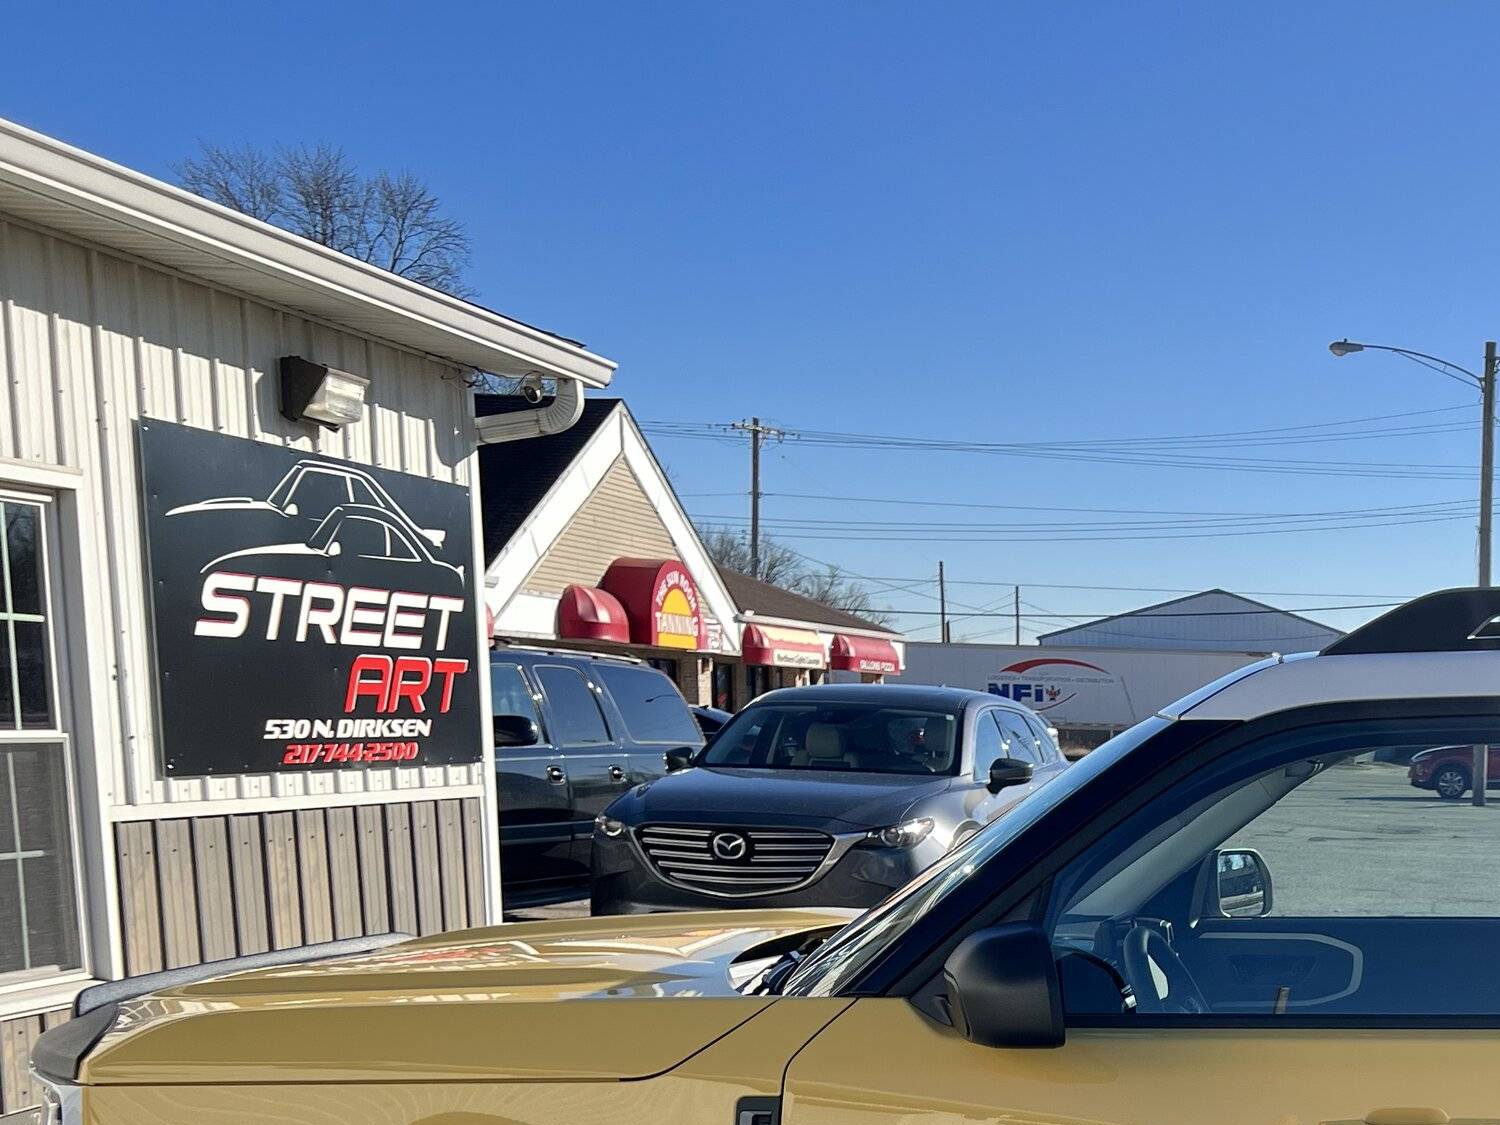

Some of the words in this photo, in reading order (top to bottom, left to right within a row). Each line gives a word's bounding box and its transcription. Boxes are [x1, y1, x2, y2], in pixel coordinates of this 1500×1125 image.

[194, 570, 465, 651] STREET
[344, 654, 470, 714] ART
[263, 719, 311, 740] 530
[311, 719, 335, 739] N.
[336, 719, 432, 738] DIRKSEN
